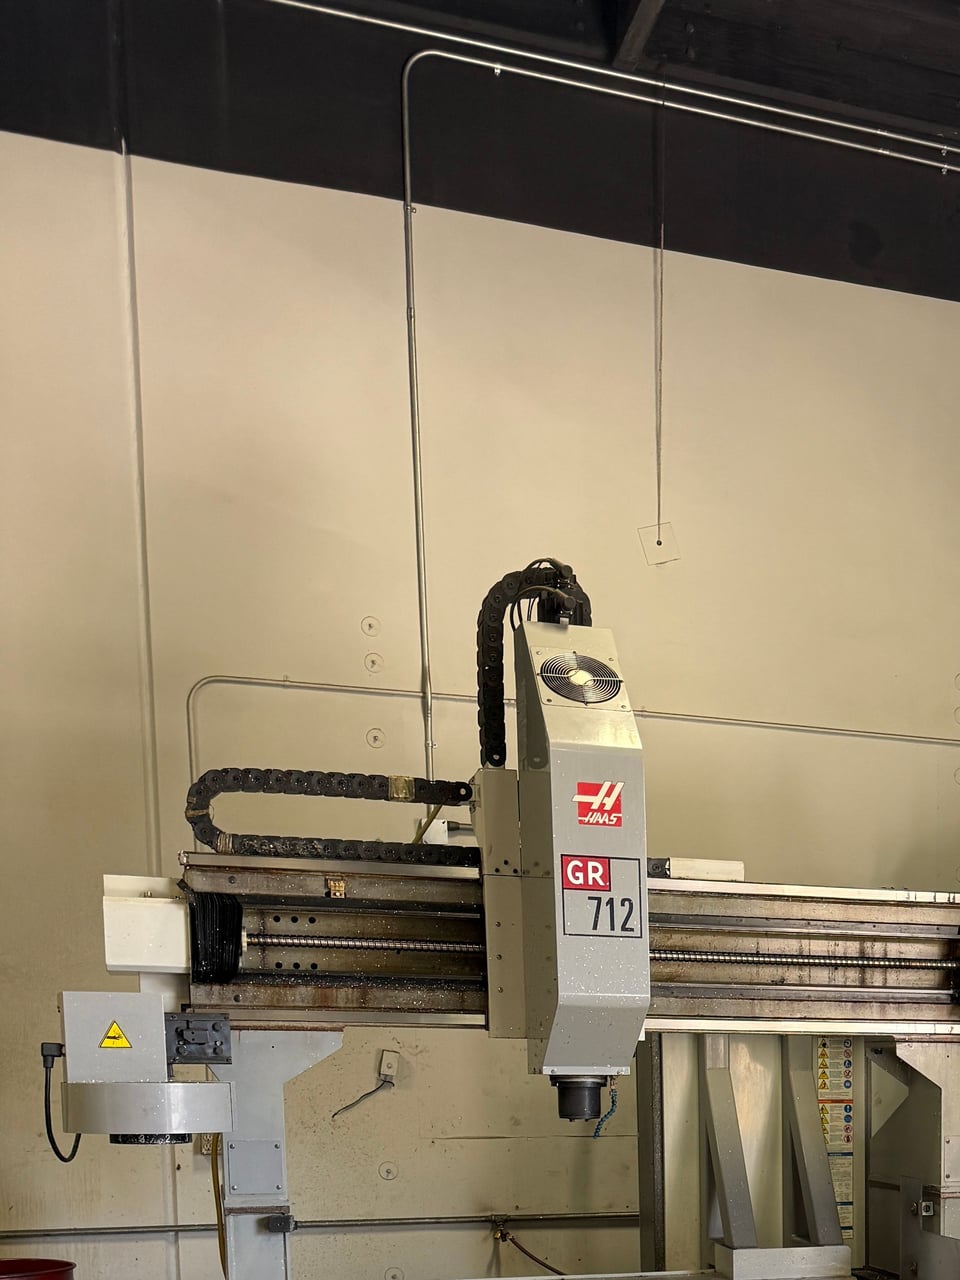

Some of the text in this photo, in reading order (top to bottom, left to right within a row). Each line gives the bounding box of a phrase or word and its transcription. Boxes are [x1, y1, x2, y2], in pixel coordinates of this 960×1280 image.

[578, 811, 622, 825] HAAS
[566, 860, 605, 886] GR
[587, 896, 635, 932] 712
